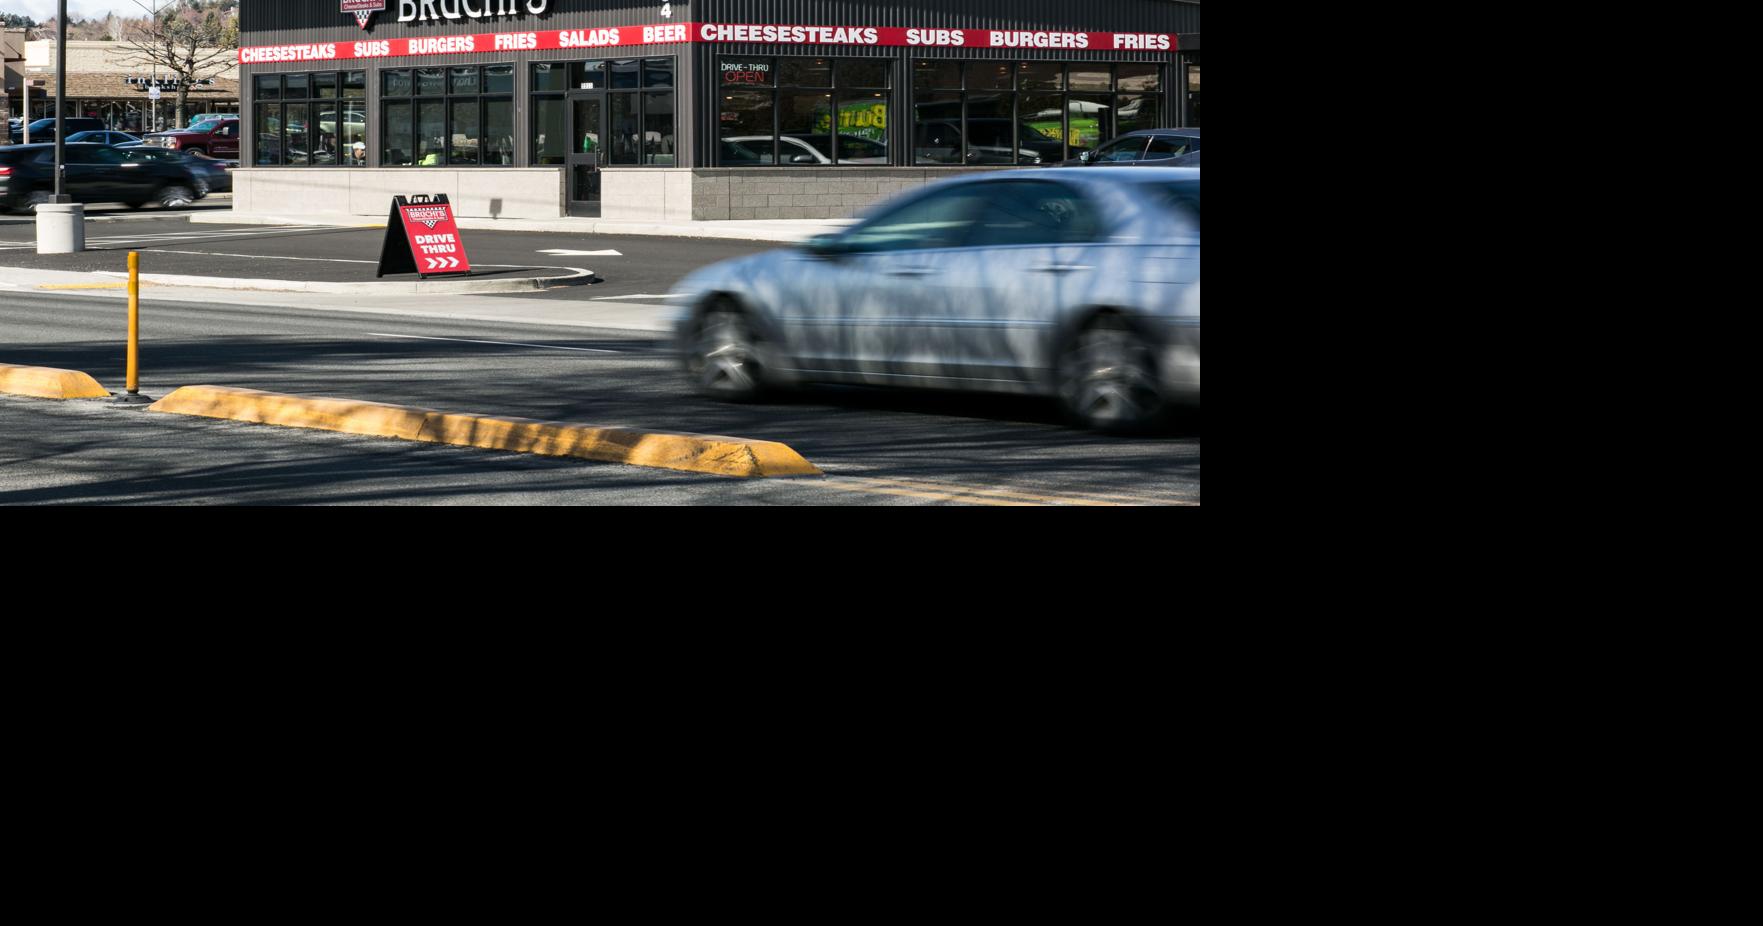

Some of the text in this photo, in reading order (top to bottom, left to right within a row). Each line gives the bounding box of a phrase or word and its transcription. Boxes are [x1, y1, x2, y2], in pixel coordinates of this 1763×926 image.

[700, 24, 1171, 50] CHEESESTEAKS SUBS BURGERS FRIES
[241, 25, 686, 62] CHEESESTEAKS SUBS BURGERS FRIES SALADS BEER
[725, 71, 765, 82] OPEN
[414, 233, 456, 244] DRIVE
[420, 244, 456, 254] THRU
